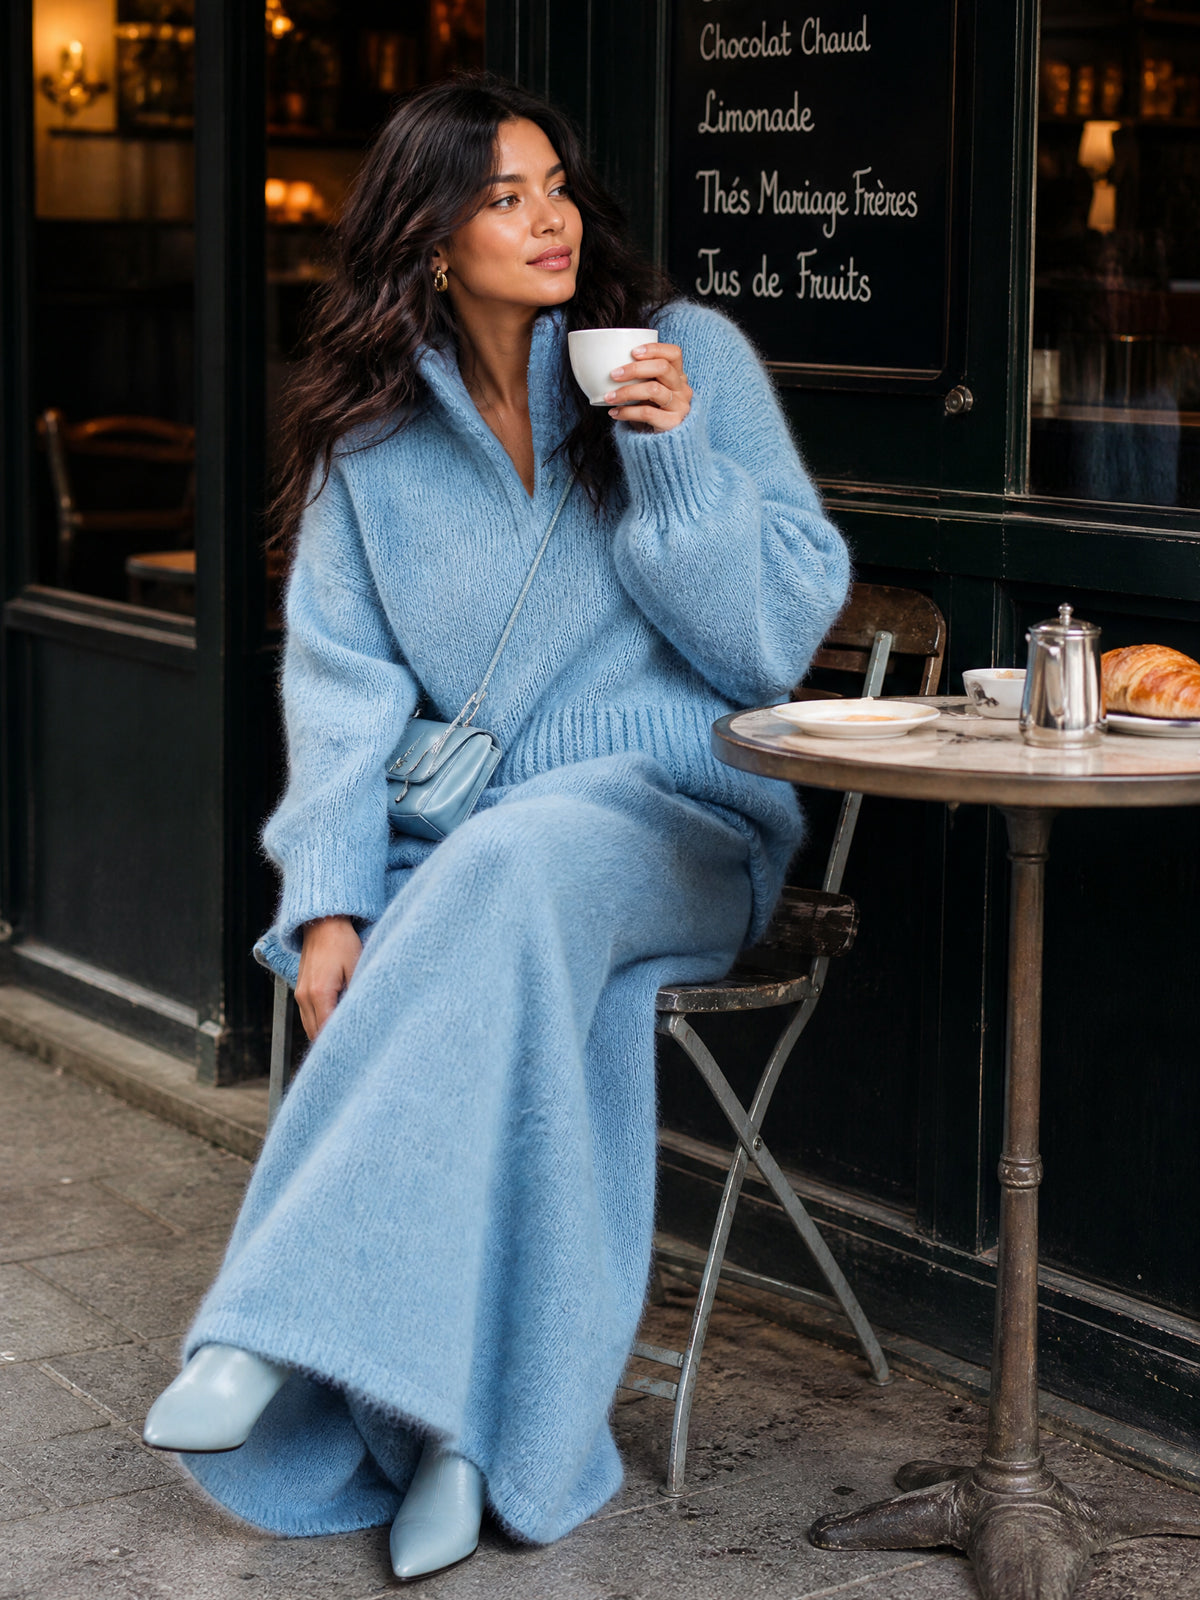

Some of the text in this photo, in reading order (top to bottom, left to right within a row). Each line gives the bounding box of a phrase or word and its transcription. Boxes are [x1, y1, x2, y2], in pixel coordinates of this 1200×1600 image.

[701, 15, 871, 60] Chocolat Chaud
[699, 90, 814, 133] Limonade
[696, 167, 917, 238] Thés Mariage Frères
[696, 249, 871, 302] Jus de Fruits
